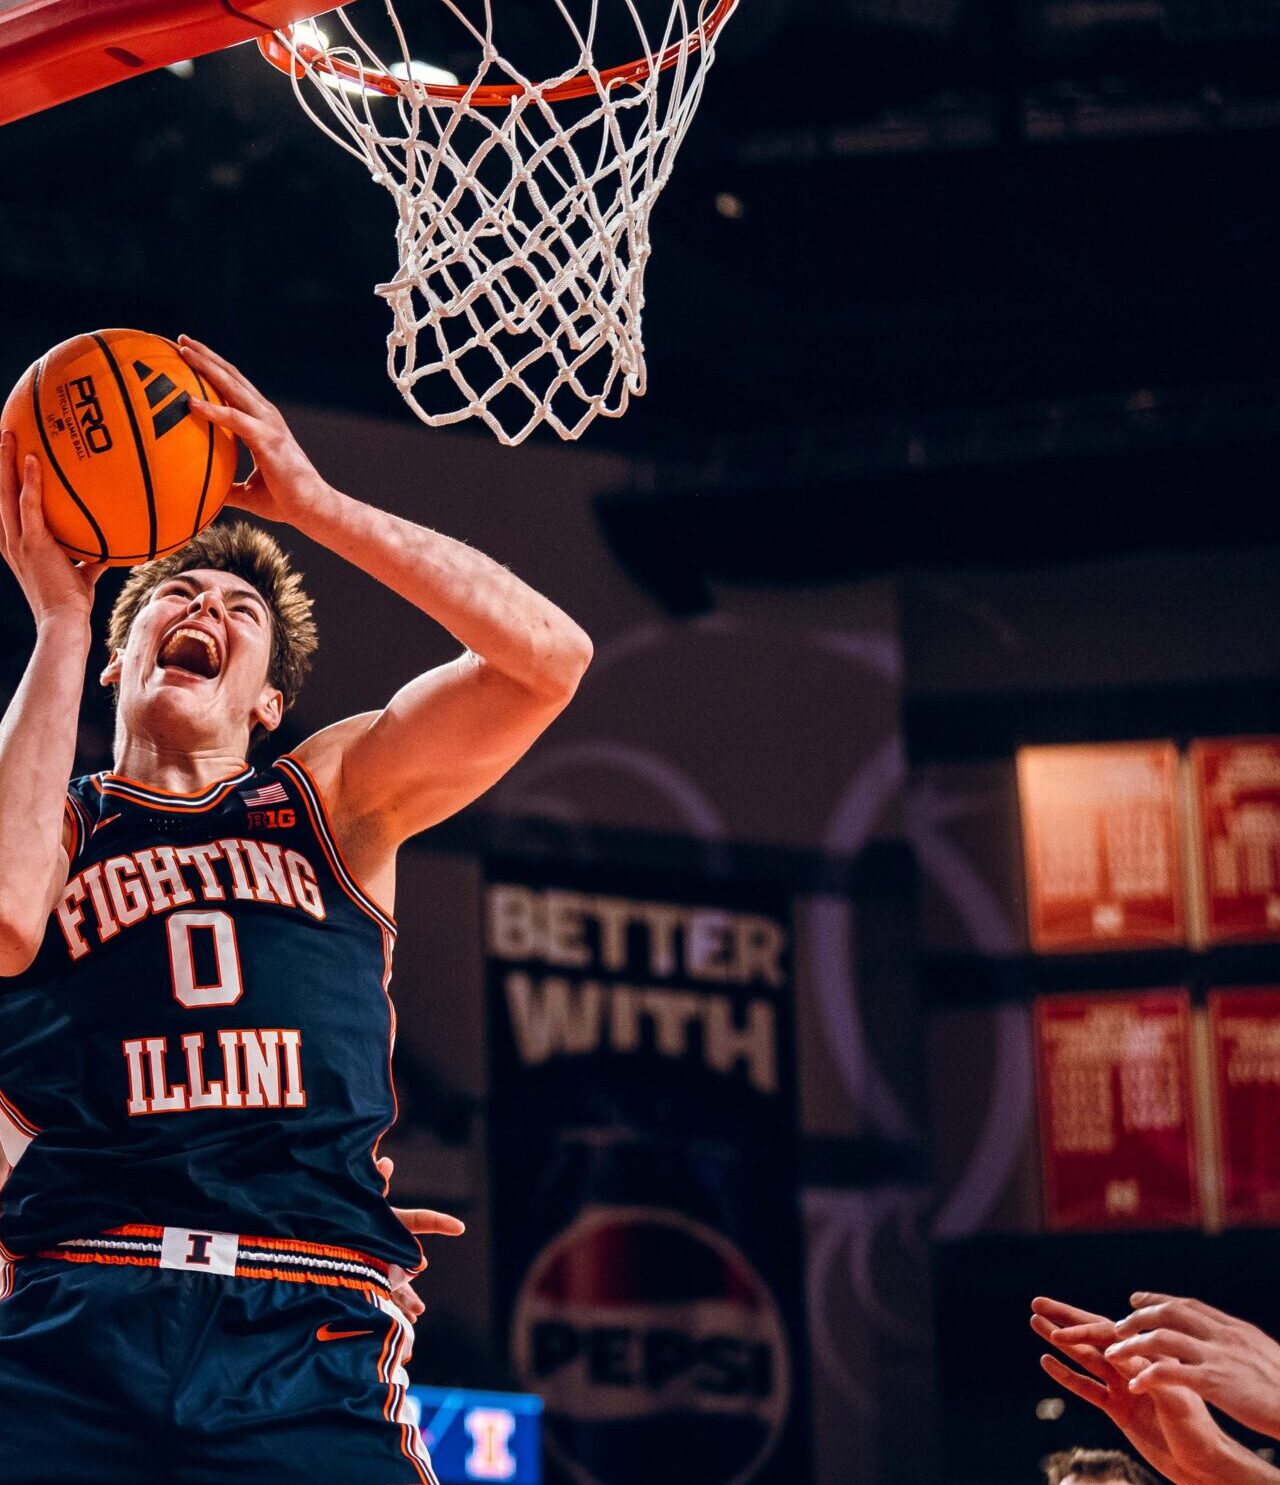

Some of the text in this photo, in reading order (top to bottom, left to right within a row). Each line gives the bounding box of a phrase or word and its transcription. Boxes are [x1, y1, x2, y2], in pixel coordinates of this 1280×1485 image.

[65, 416, 78, 440] GAME
[72, 439, 86, 461] BALL
[69, 374, 113, 454] PRO
[53, 838, 327, 962] FIGHTING
[488, 881, 787, 989] BETTER
[165, 909, 244, 1009] 0
[122, 1028, 307, 1117] ILLINI
[505, 968, 778, 1096] WITH
[185, 1233, 213, 1266] I
[532, 1319, 774, 1398] PEPSI
[463, 1404, 517, 1481] I
